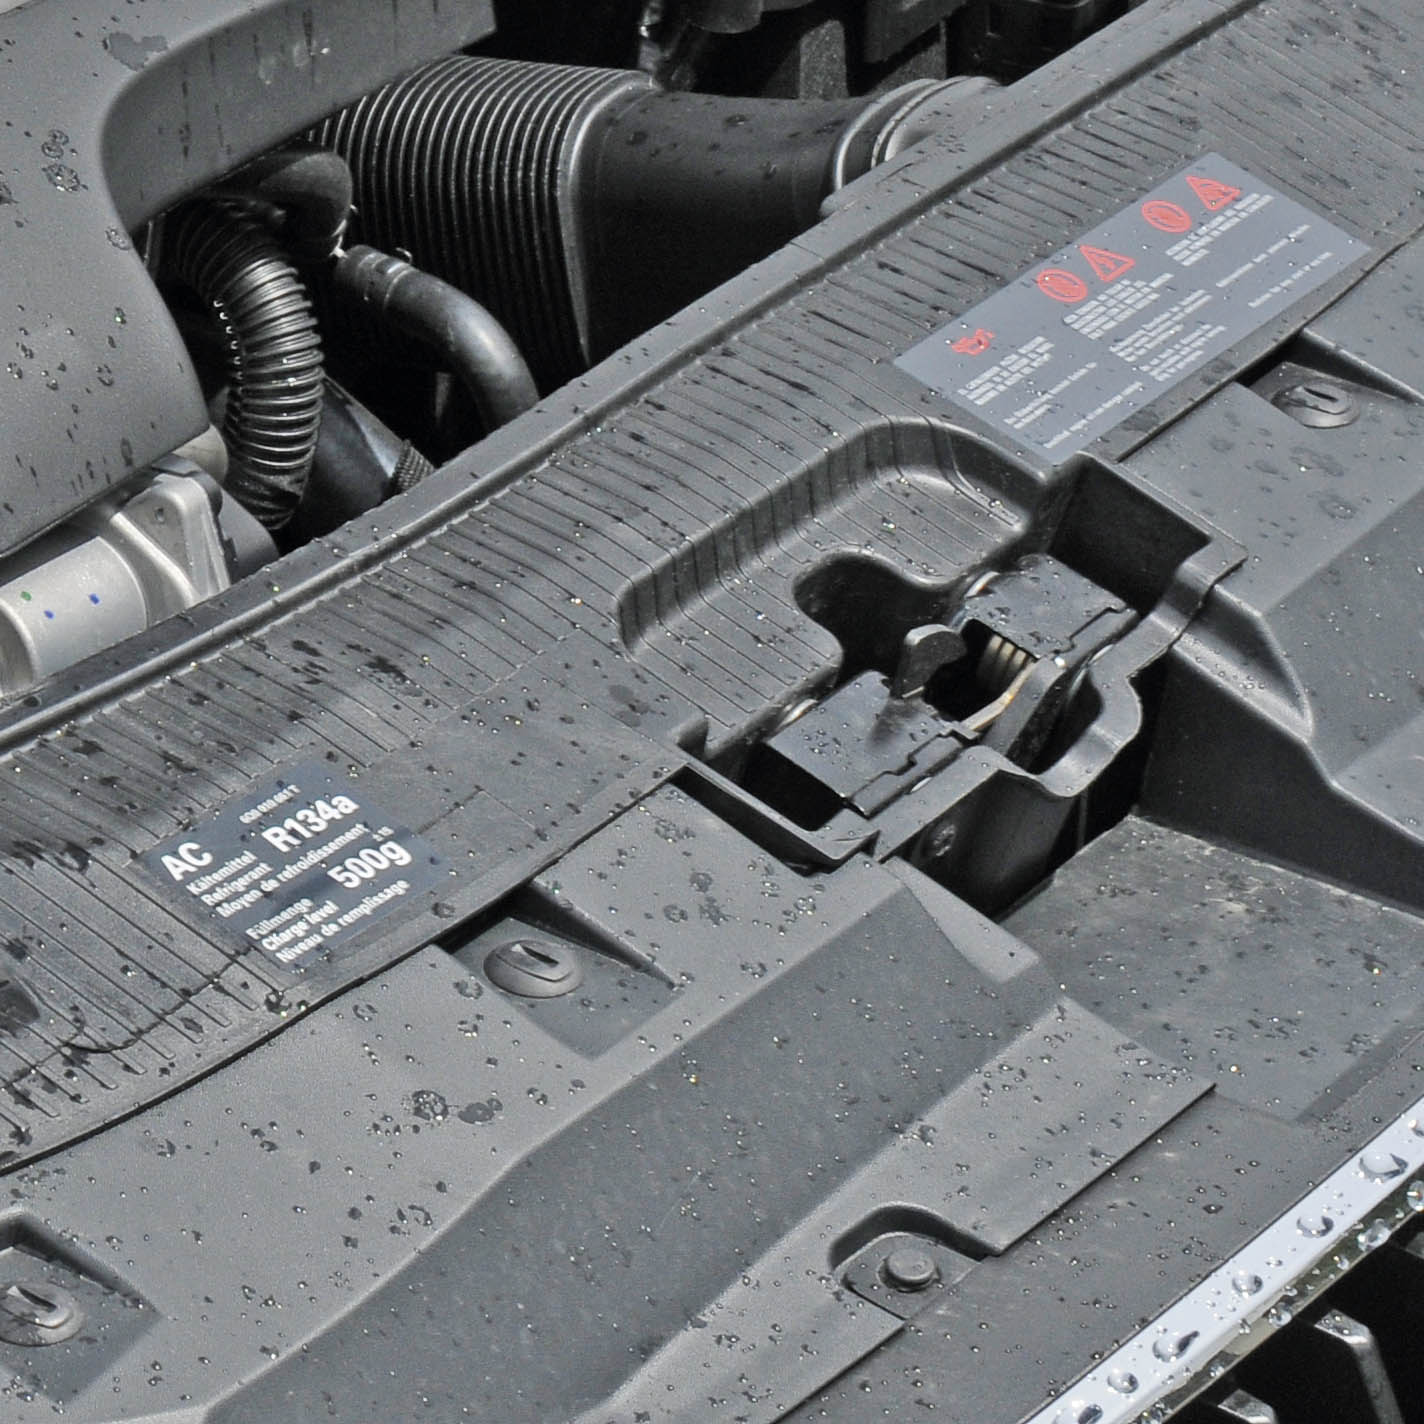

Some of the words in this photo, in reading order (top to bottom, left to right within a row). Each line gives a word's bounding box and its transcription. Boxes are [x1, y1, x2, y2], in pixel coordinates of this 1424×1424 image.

[261, 795, 359, 853] R134a
[160, 842, 213, 881] AC
[186, 850, 257, 895] Kältemittel
[200, 862, 273, 906] Refrigerant
[215, 889, 263, 918] Moyen
[260, 878, 280, 892] de
[276, 823, 370, 882] refroidissement
[327, 837, 412, 889] 500g
[245, 898, 313, 940] Füllmenge
[261, 921, 310, 951] Charge
[303, 900, 339, 925] level
[275, 933, 324, 963] Niveau
[320, 923, 341, 937] de
[337, 880, 410, 926] remplissage
